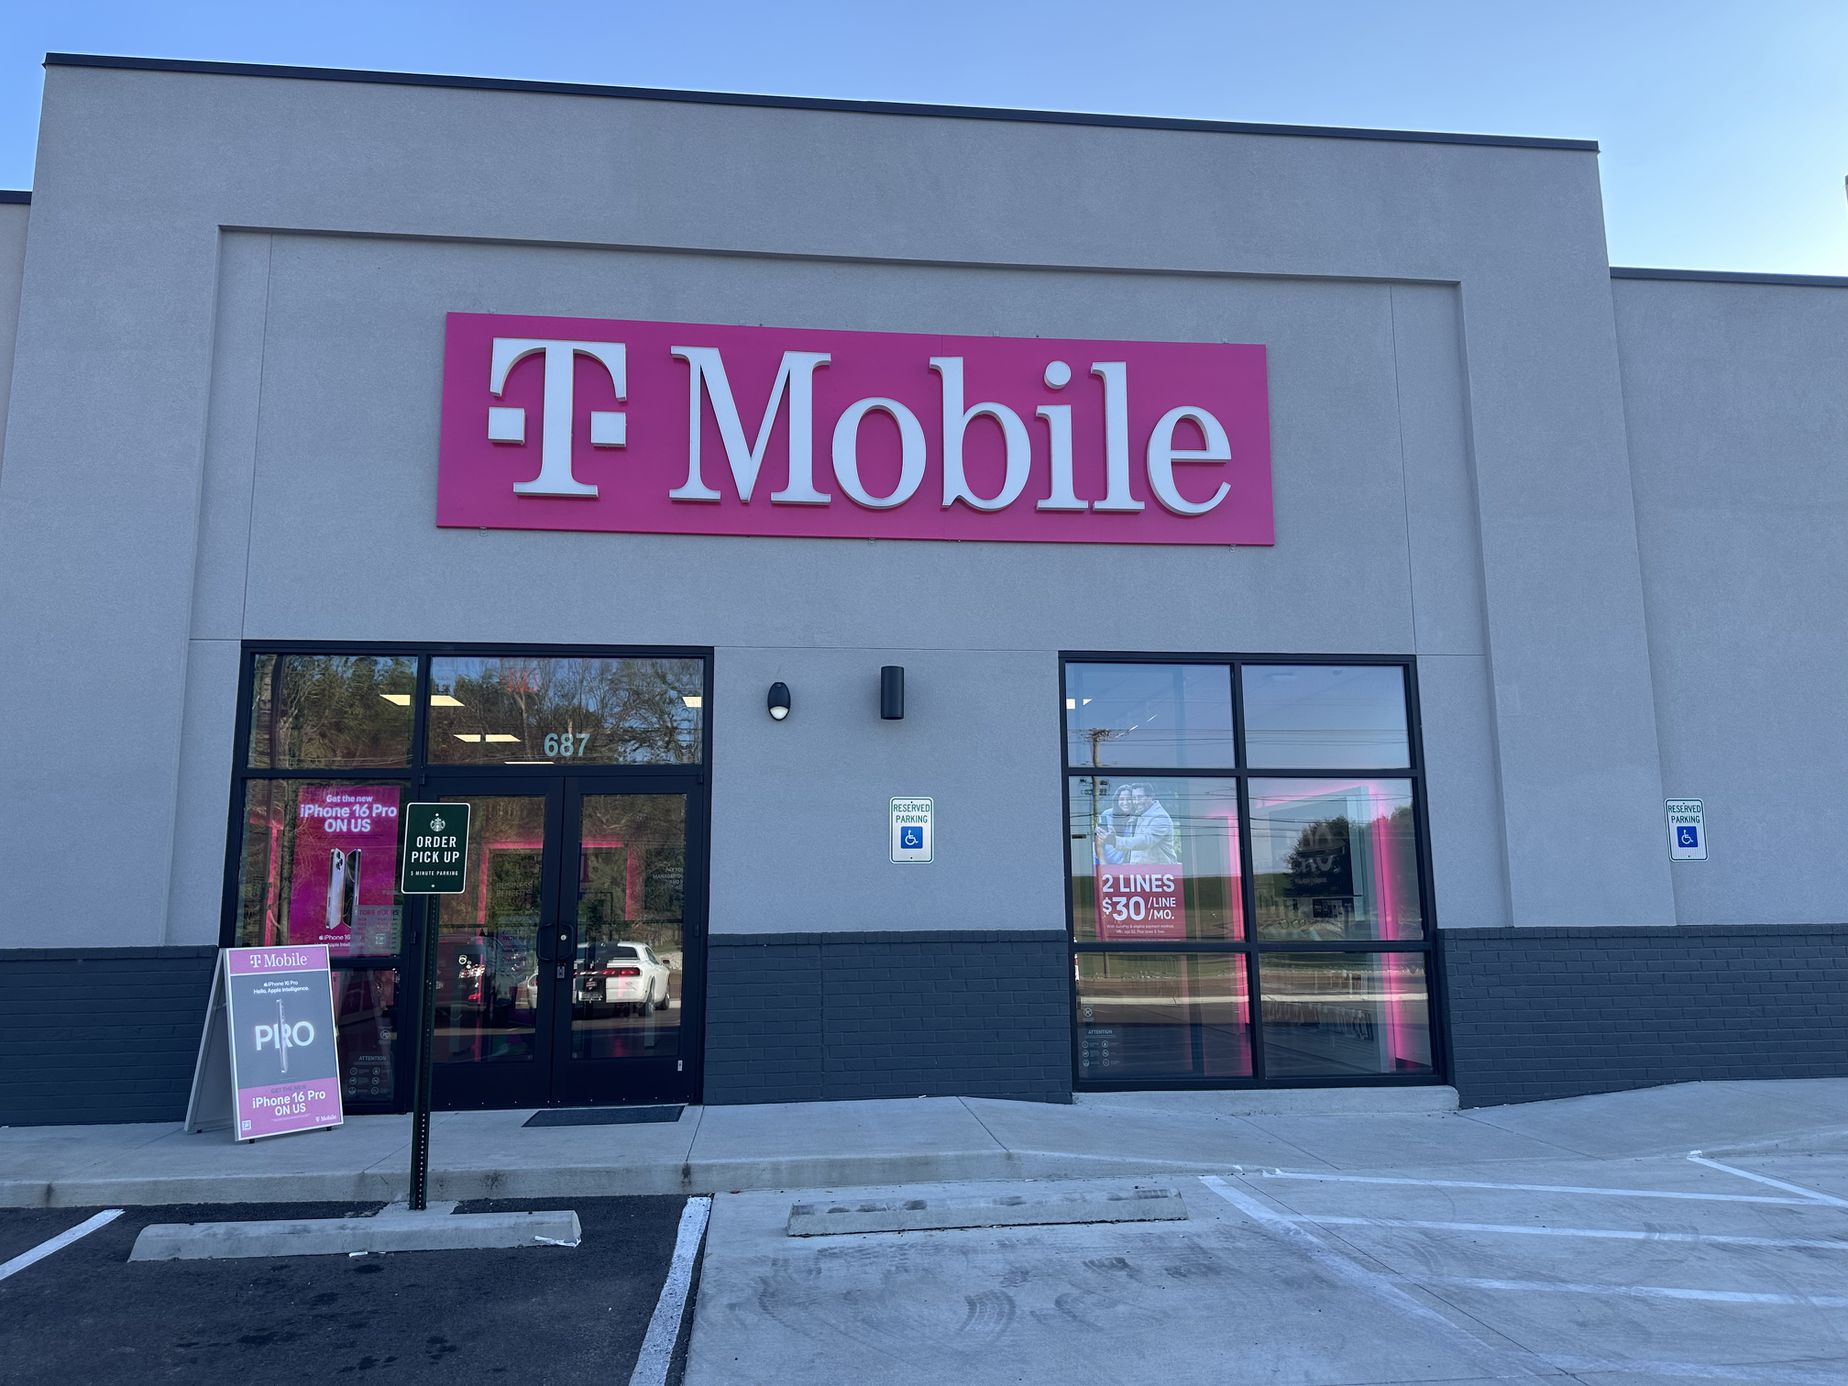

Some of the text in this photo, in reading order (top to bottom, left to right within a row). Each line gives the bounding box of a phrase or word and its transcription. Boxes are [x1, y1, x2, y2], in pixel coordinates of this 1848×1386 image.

[487, 336, 1233, 516] T Mobile
[544, 732, 591, 757] 687
[300, 803, 397, 818] iPhone 16 Pro
[893, 803, 930, 813] RESERVED
[1667, 804, 1702, 813] RESERVED
[324, 818, 371, 832] ON US
[895, 815, 928, 823] PARKING
[1671, 815, 1701, 823] PARKING
[416, 836, 457, 848] ORDER
[411, 851, 460, 863] PICK UP
[1102, 873, 1175, 892] 2 LINES
[1102, 896, 1177, 921] $30 /LINE
[1147, 909, 1175, 921] /MO.
[249, 952, 308, 968] T Mobile
[255, 1021, 315, 1051] PRO
[252, 1090, 326, 1109] iPhone 16 Pro
[275, 1103, 306, 1116] ON US
